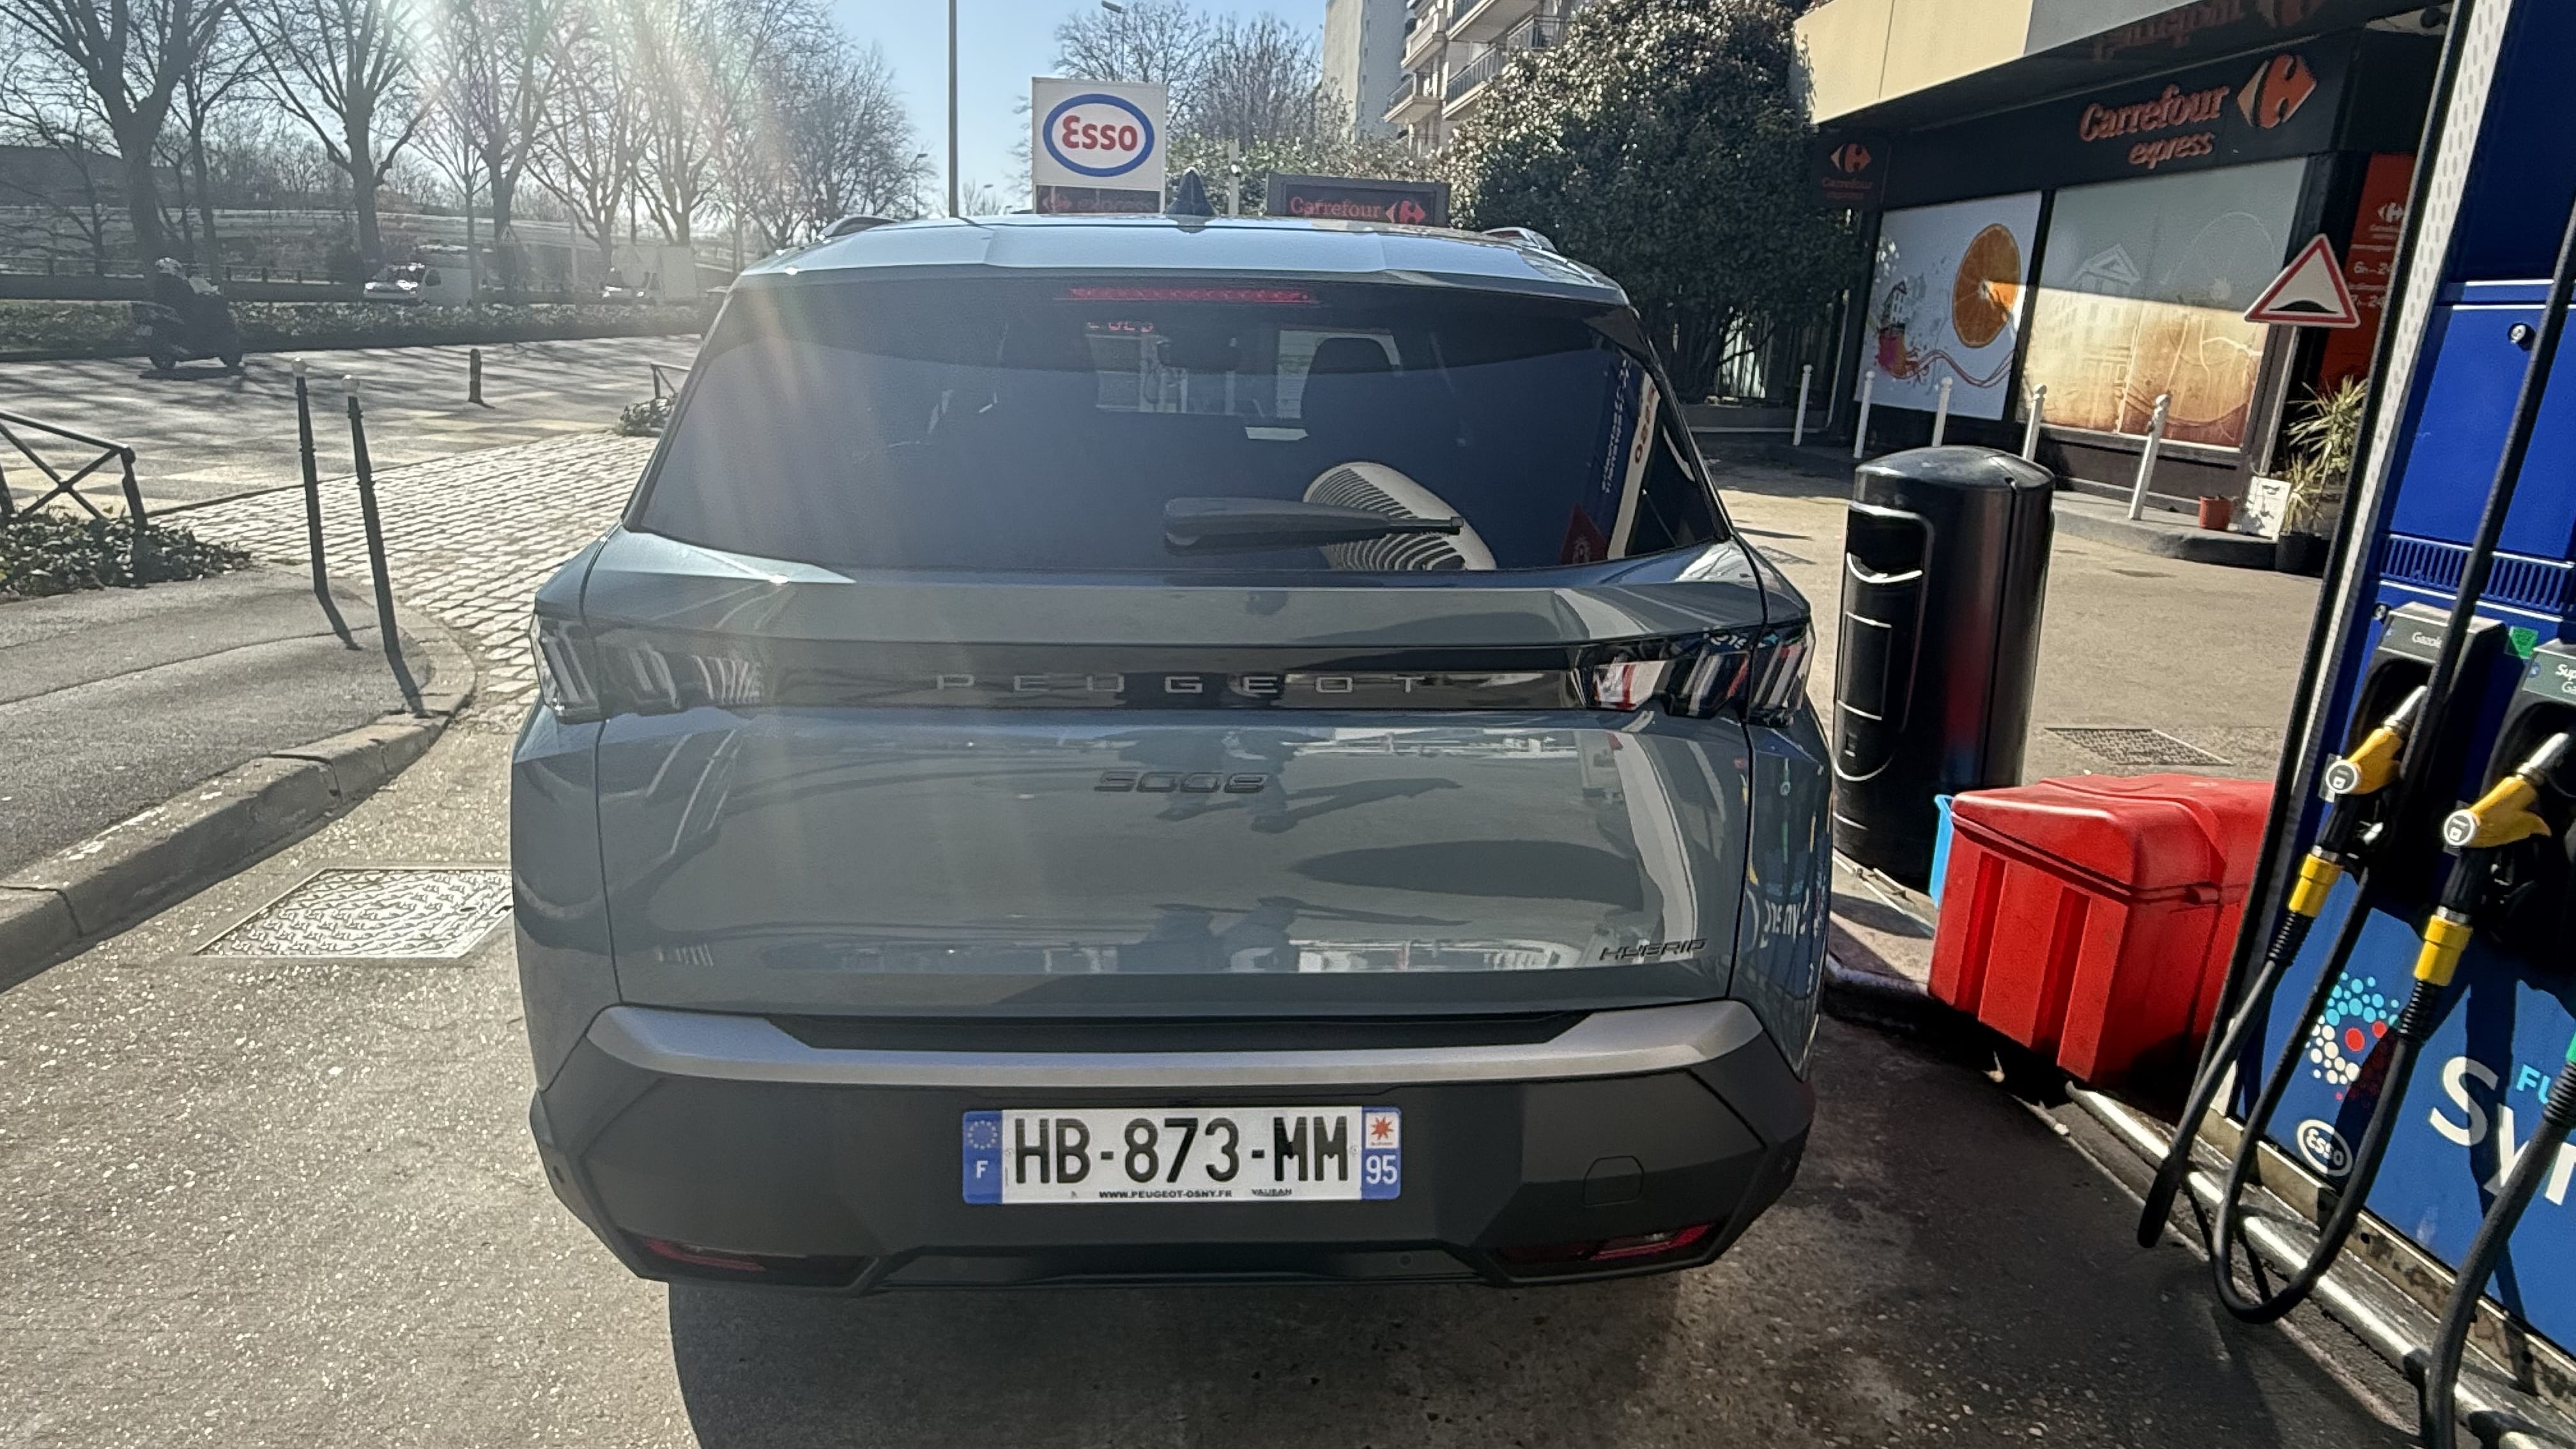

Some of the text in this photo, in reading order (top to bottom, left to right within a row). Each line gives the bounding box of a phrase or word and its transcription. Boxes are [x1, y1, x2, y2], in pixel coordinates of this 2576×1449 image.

[2079, 83, 2230, 141] Carrefour
[2128, 132, 2216, 169] express
[1291, 196, 1381, 218] Carrefour
[937, 673, 1425, 694] PEUGEOT
[1094, 770, 1275, 793] 5008
[1599, 939, 1707, 961] HYBRID
[1015, 1117, 1349, 1184] HB-873-MM
[976, 1160, 989, 1179] F
[1366, 1154, 1398, 1184] 95
